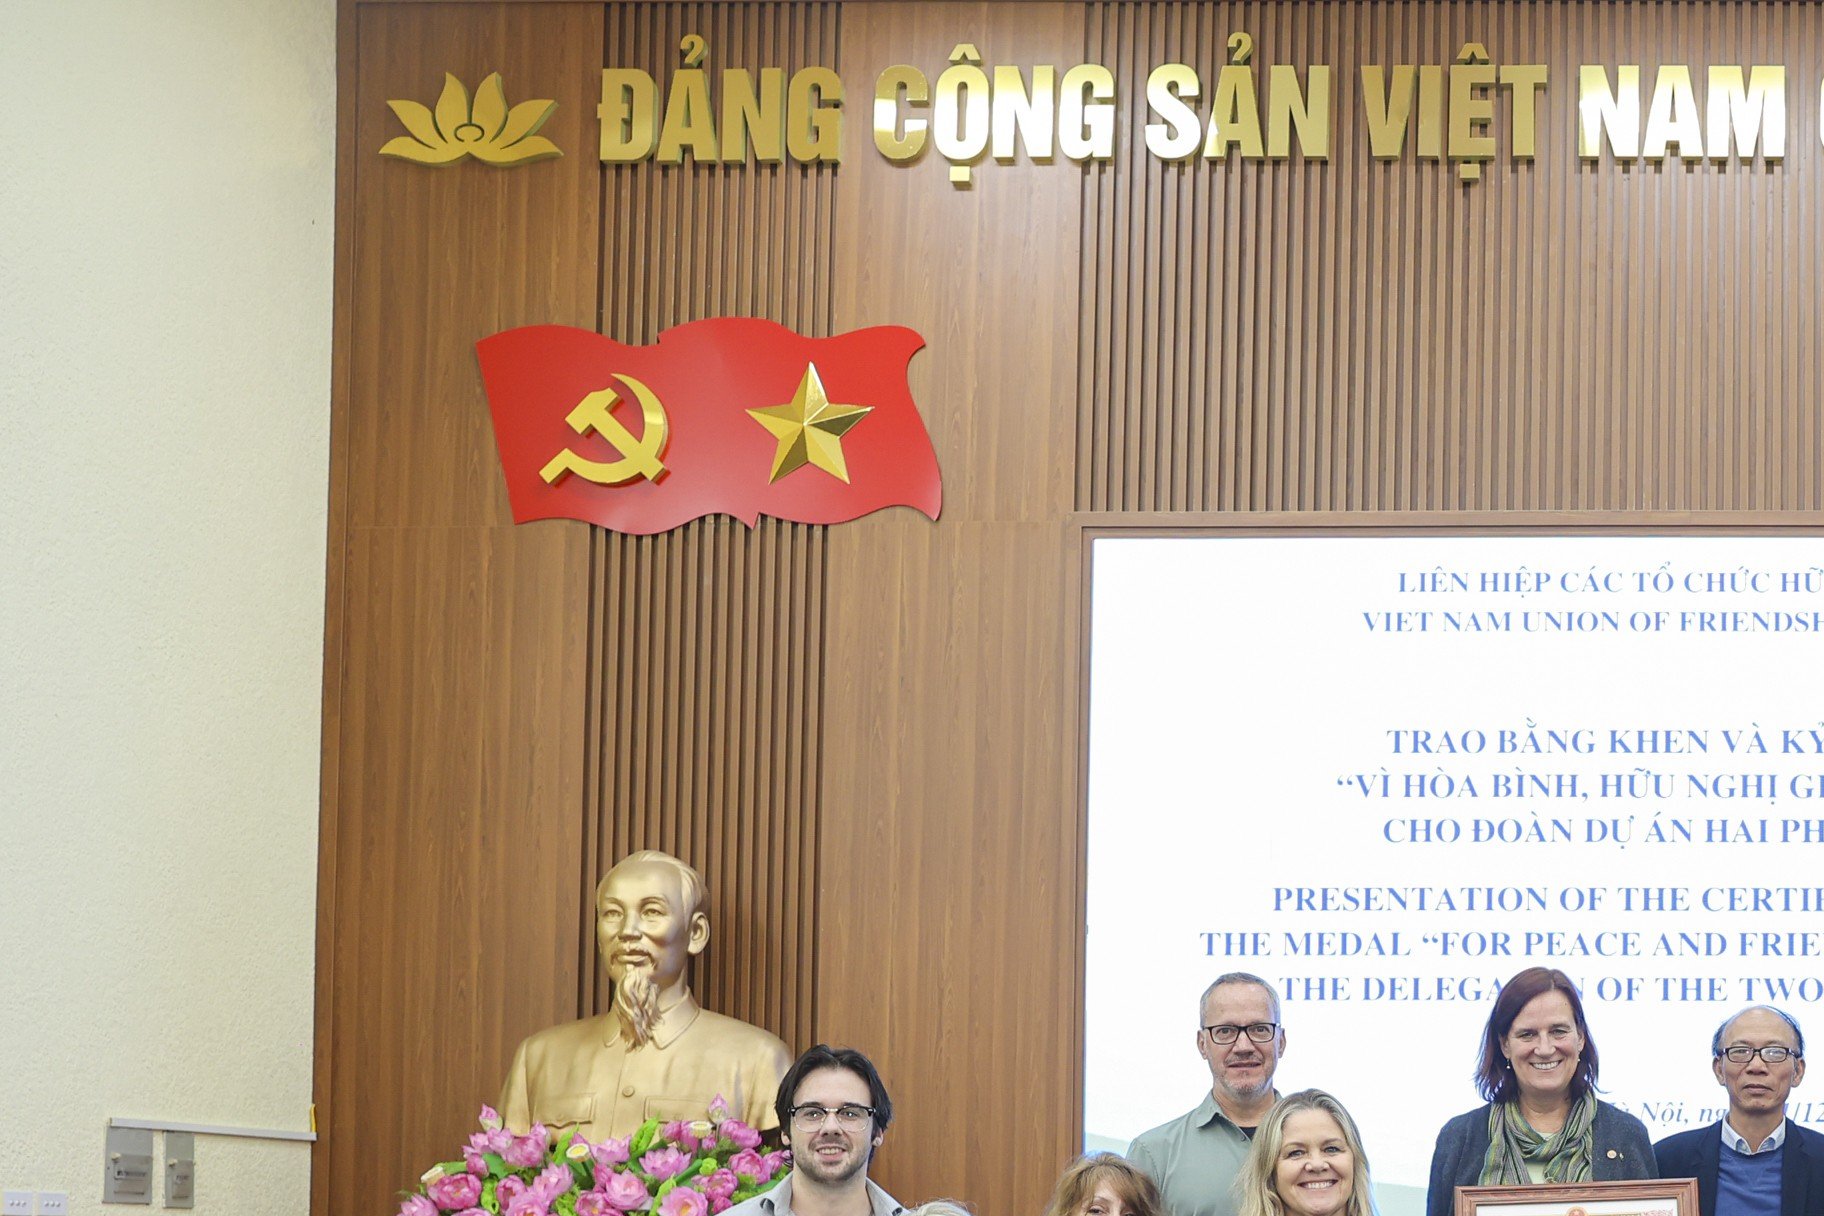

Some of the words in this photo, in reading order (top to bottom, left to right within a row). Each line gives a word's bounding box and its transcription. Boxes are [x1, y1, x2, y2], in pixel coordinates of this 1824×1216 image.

[597, 34, 843, 164] ĐẢNG
[873, 43, 1115, 187] CỘNG
[1145, 32, 1330, 161] SẢN
[1361, 42, 1547, 182] VIỆT
[1579, 64, 1786, 161] NAM
[1398, 566, 1469, 593] LIÊN
[1480, 566, 1552, 598] HIỆP
[1560, 566, 1624, 593] CÁC
[1632, 561, 1675, 593] TỔ
[1683, 566, 1771, 593] CHỨC
[1362, 611, 1433, 632] VIET
[1443, 611, 1512, 632] NAM
[1522, 611, 1620, 632] UNION
[1629, 611, 1670, 632] OF
[1386, 729, 1487, 755] TRAO
[1497, 717, 1596, 755] BẰNG
[1608, 729, 1709, 754] KHEN
[1722, 721, 1768, 755] VÀ
[1402, 767, 1478, 799] HÒA
[1492, 767, 1590, 803] BÌNH,
[1600, 767, 1675, 799] HỮU
[1686, 773, 1779, 805] NGHỊ
[1383, 818, 1461, 844] CHO
[1472, 811, 1572, 844] ĐOÀN
[1585, 815, 1637, 850] DỰ
[1645, 811, 1695, 844] ÁN
[1704, 818, 1773, 845] HAI
[1273, 886, 1549, 912] PRESENTATION
[1555, 886, 1606, 912] OF
[1617, 886, 1691, 912] THE
[1200, 931, 1272, 957] THE
[1283, 931, 1411, 957] MEDAL
[1523, 931, 1642, 957] PEACE
[1653, 931, 1728, 957] AND
[1279, 977, 1351, 1001] THE
[1597, 977, 1642, 1001] OF
[1655, 977, 1728, 1001] THE
[1739, 977, 1824, 1002] TWO
[1641, 1102, 1689, 1127] Nội,
